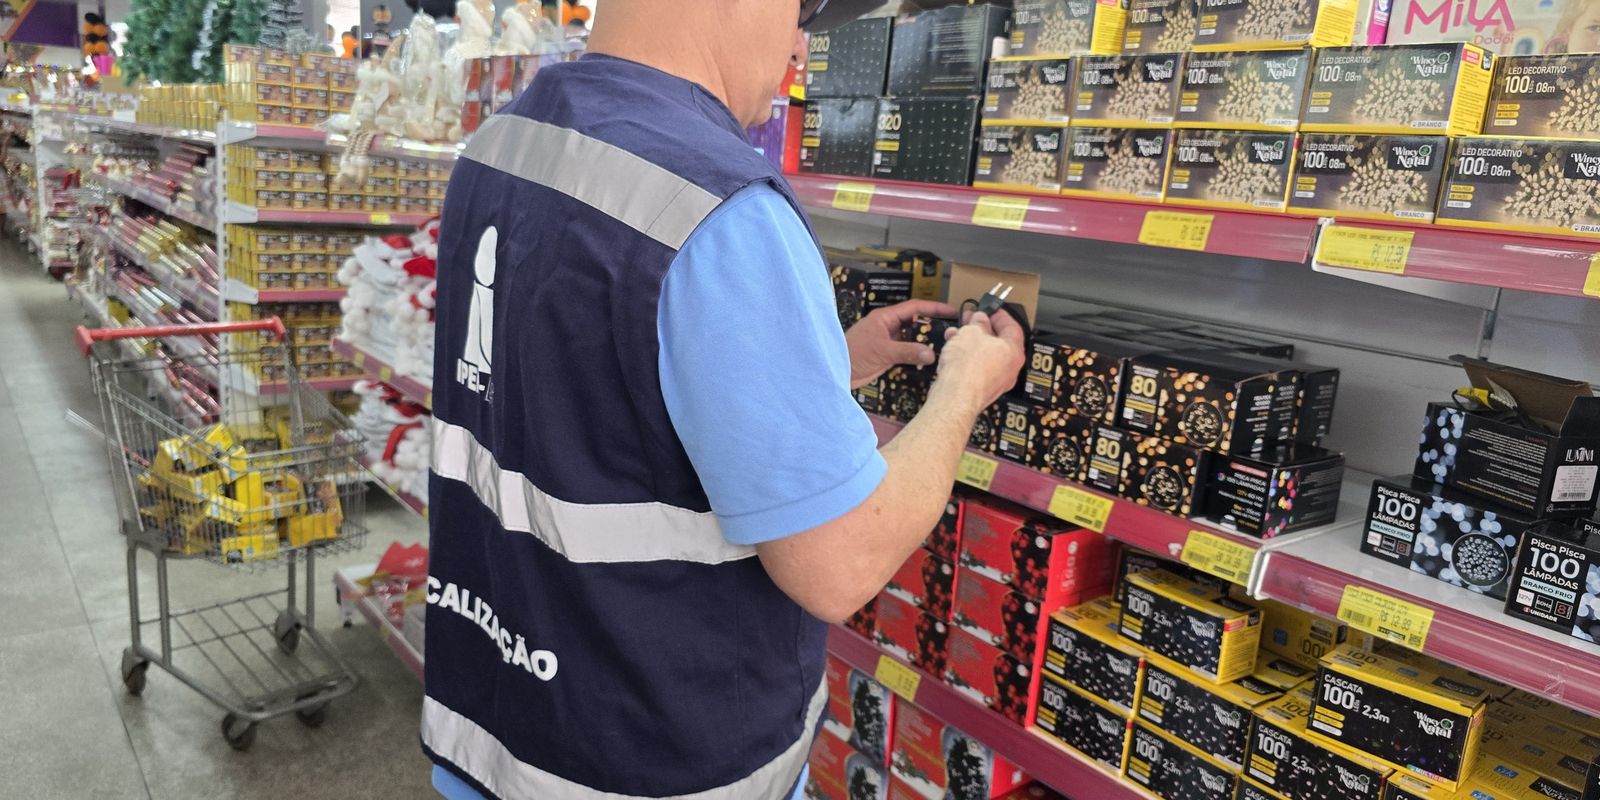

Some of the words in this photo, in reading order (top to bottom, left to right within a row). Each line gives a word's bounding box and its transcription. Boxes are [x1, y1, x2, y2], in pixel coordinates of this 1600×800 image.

[810, 36, 830, 52] 320
[1335, 56, 1371, 64] DECORATIVO
[1410, 56, 1436, 66] Wincy
[1083, 71, 1099, 84] 100
[1188, 68, 1206, 84] 100
[1267, 67, 1297, 80] Natal
[1319, 66, 1340, 82] 100
[1344, 71, 1362, 82] 08m
[1415, 63, 1448, 77] Natal
[1508, 67, 1522, 75] LED
[1522, 65, 1566, 74] DECORATIVO
[1505, 75, 1530, 93] 100
[1535, 82, 1556, 93] 08m
[804, 112, 822, 129] 320
[877, 113, 902, 130] 320
[1073, 143, 1090, 157] 100
[1178, 147, 1196, 162] 100
[1256, 149, 1283, 161] Natal
[1306, 143, 1317, 151] LED
[1318, 144, 1355, 152] DECORATIVO
[1392, 146, 1420, 156] Wincy
[1462, 148, 1476, 156] LED
[1477, 148, 1523, 158] DECORATIVO
[1303, 152, 1325, 168] 100
[1329, 158, 1346, 169] 08m
[1397, 155, 1431, 168] Natal
[1458, 157, 1485, 176] 100
[1490, 165, 1511, 177] 08m
[1031, 352, 1053, 373] 80
[1130, 375, 1157, 397] 80
[1005, 411, 1027, 431] 80
[1096, 437, 1120, 459] 80
[1377, 486, 1399, 498] Pisca
[1399, 492, 1421, 504] Pisca
[1377, 494, 1417, 521] 100
[1372, 512, 1416, 531] LÂMPADAS
[1530, 538, 1557, 552] Pisca
[1559, 546, 1586, 560] Pisca
[1530, 546, 1580, 579] 100
[1523, 567, 1579, 590] LÂMPADAS
[1523, 580, 1554, 594] BRANCO
[1555, 590, 1573, 600] FRIO
[1127, 594, 1150, 617] 100
[1530, 609, 1557, 622] UNIDADE
[1052, 631, 1073, 652] 100
[1324, 674, 1364, 695] CASCATA
[1043, 688, 1064, 710] 100
[1147, 676, 1171, 700] 100
[1175, 696, 1195, 713] 2,3m
[1323, 683, 1355, 710] 100
[1362, 704, 1390, 724] 2,3m
[1413, 710, 1441, 727] Wincy
[1258, 724, 1293, 747] CASCATA
[1418, 720, 1453, 739] Natal
[1135, 737, 1159, 761] 100
[1258, 733, 1286, 760] 100
[1291, 756, 1316, 776] 2,3m
[1335, 764, 1359, 781] Wincy
[1340, 775, 1369, 794] Natal
